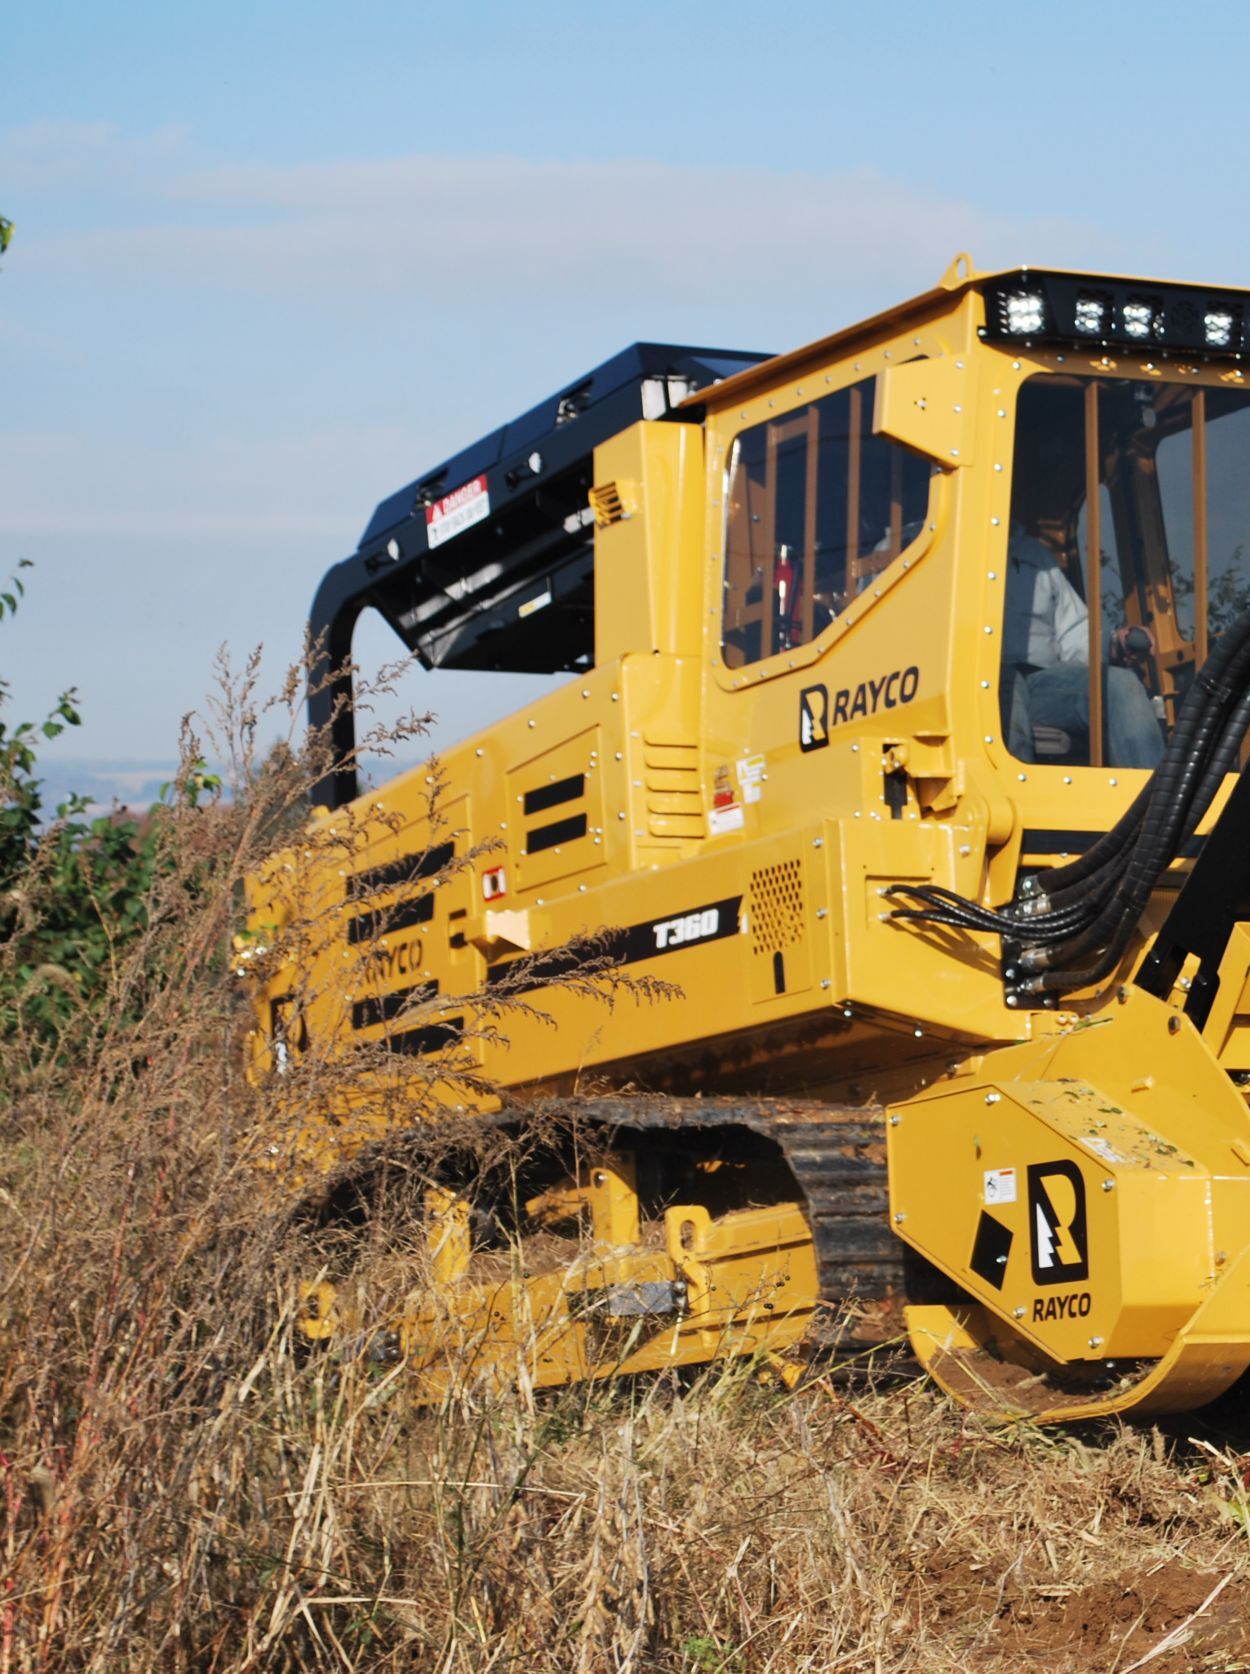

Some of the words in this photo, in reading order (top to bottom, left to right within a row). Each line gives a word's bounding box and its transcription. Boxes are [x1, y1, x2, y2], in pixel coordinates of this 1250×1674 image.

[832, 666, 919, 726] RAYCO
[653, 908, 719, 949] T360
[1033, 1293, 1091, 1323] RAYCO
